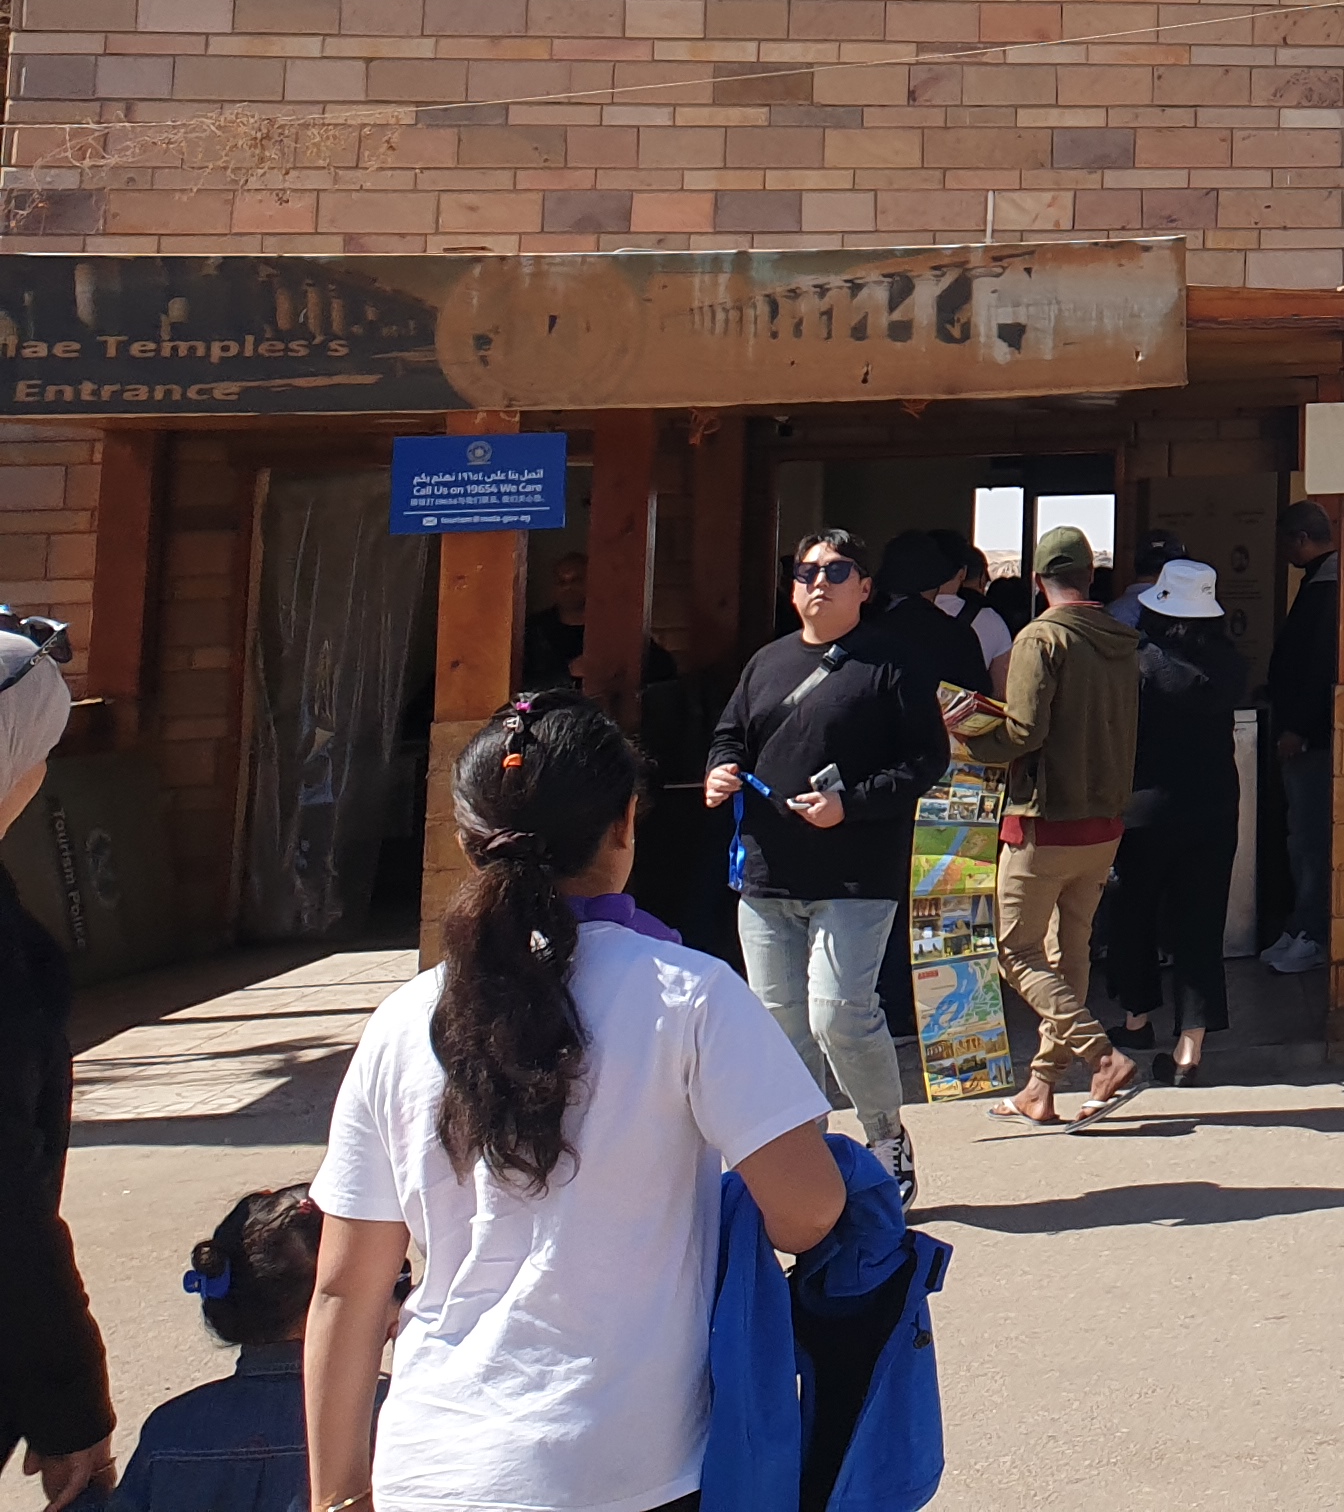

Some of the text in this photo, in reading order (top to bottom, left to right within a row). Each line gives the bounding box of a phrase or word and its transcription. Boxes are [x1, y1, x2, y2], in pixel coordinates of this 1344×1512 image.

[0, 334, 350, 364] lae Temples's
[13, 379, 242, 403] Entrance
[413, 482, 542, 496] Call Us on 19654 We Care
